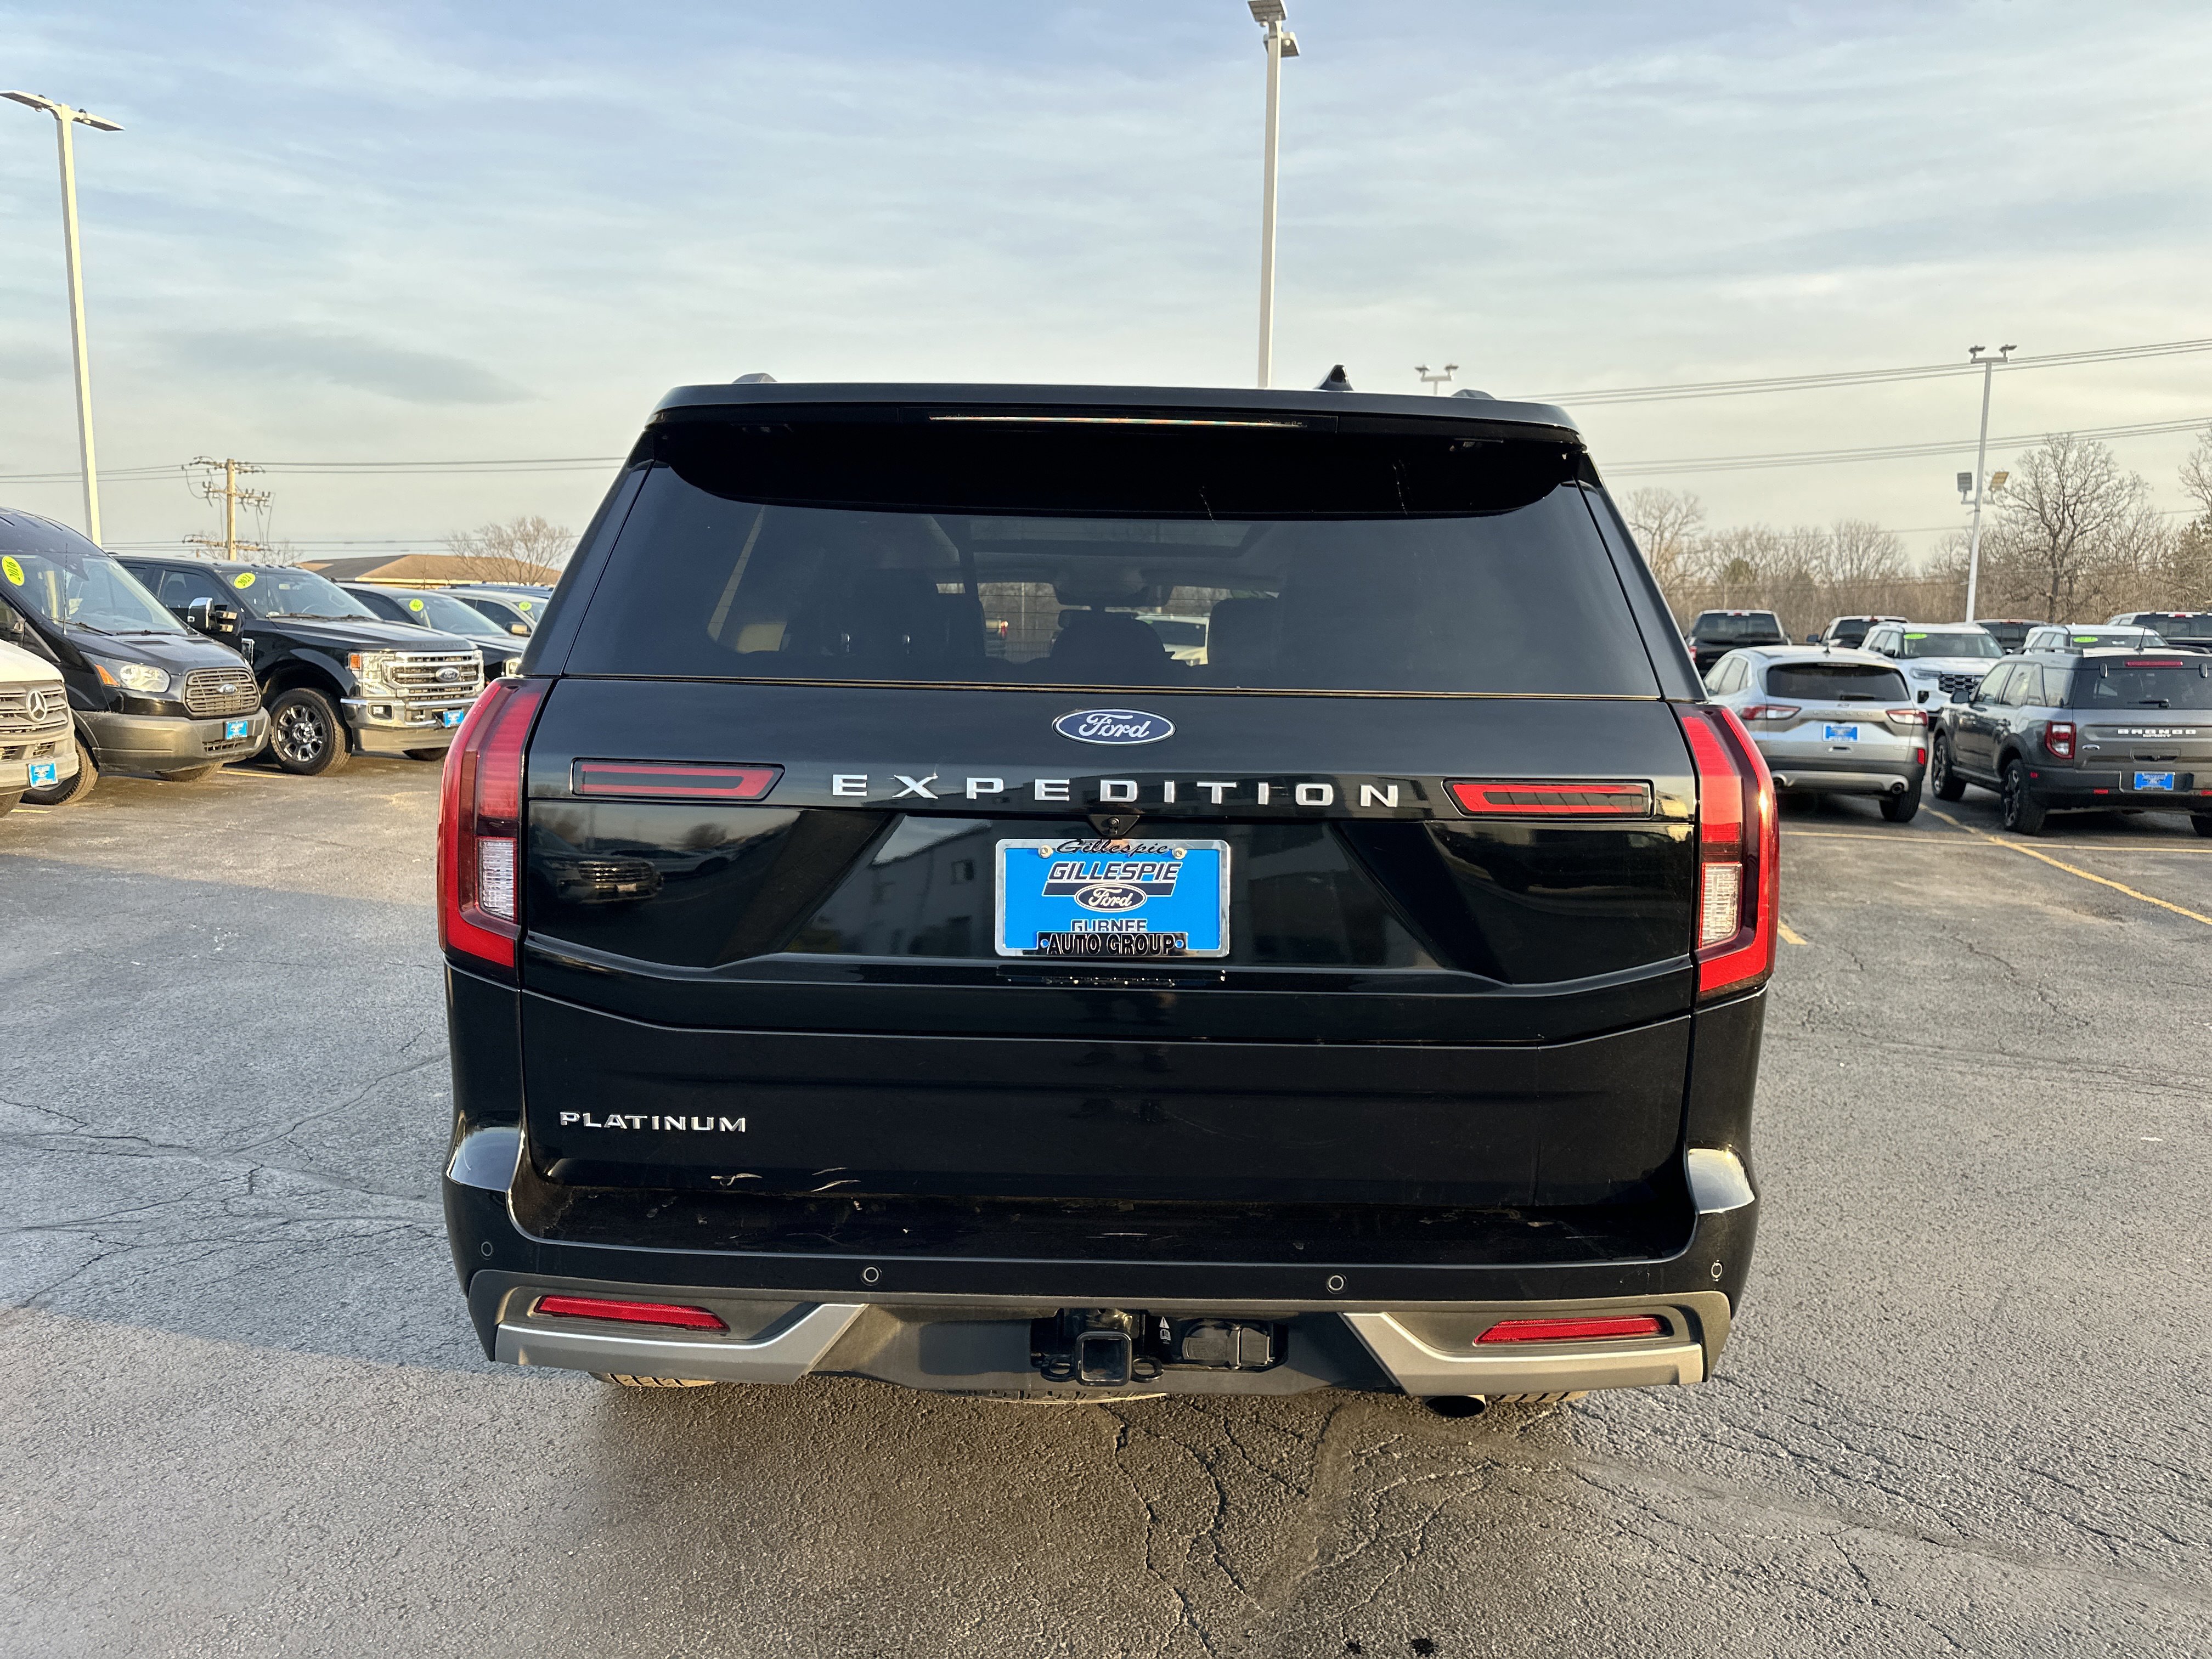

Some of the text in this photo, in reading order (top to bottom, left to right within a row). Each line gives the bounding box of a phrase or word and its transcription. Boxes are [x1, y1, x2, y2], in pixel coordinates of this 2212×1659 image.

[1079, 713, 1152, 738] Ford
[832, 774, 1399, 808] EXPEDITION
[1054, 838, 1170, 858] Gillespie
[1048, 861, 1183, 881] GILLESPIE
[1088, 888, 1132, 906] Ford
[1046, 933, 1176, 956] AUTO GROUP
[559, 1111, 746, 1132] PLATINUM
